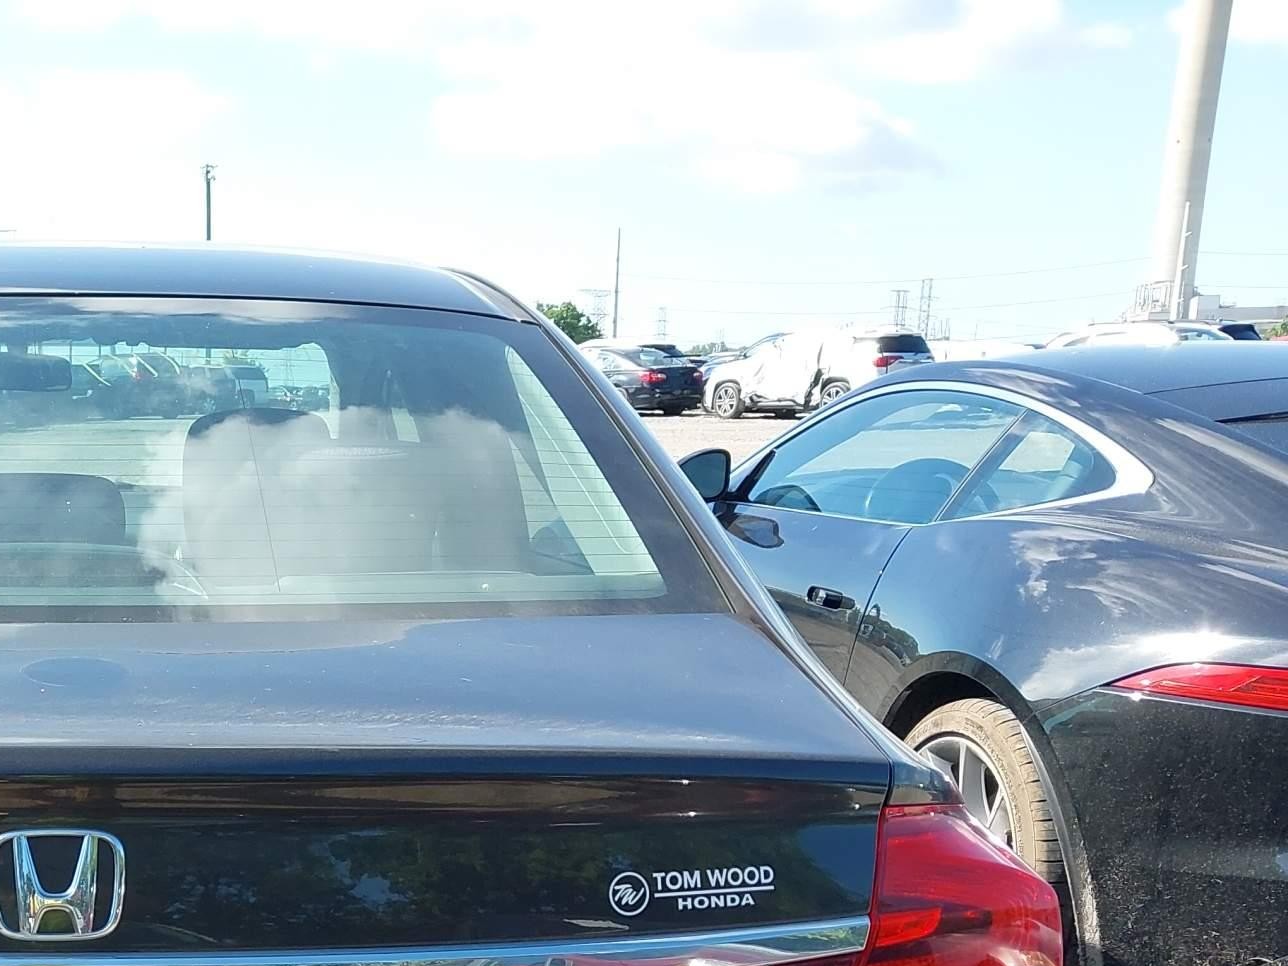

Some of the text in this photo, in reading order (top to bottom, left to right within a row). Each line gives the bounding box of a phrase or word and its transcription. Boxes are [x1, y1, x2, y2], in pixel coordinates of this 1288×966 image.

[653, 865, 775, 891] TOM WOOD
[678, 893, 755, 911] HONDA
